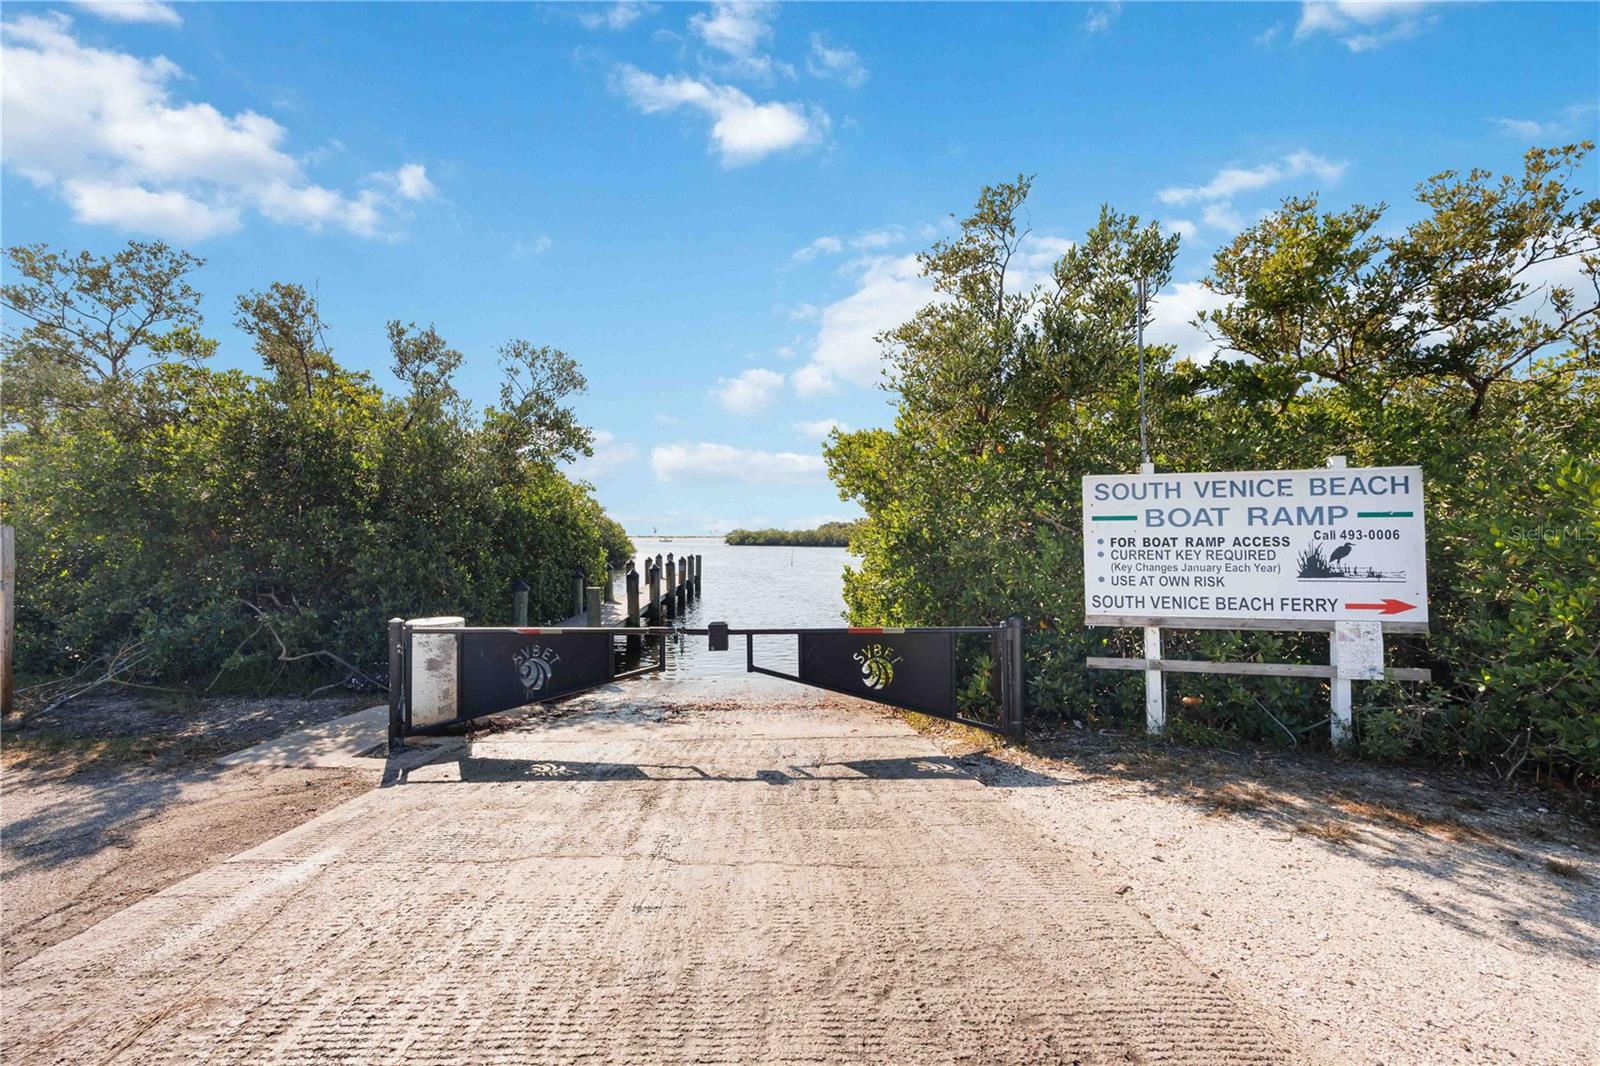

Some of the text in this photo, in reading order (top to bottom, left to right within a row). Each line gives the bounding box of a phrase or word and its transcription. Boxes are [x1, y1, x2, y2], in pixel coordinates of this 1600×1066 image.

[1094, 476, 1409, 500] SOUTH VENICE BEACH
[1145, 505, 1348, 527] BOAT RAMP
[1314, 529, 1400, 541] Call 493-0006
[1111, 536, 1290, 548] FOR BOAT RAMP ACCESS
[1111, 550, 1276, 562] CURRENT KEY REQUIRED
[1111, 563, 1281, 574] (Key Changes January Each Year)
[1111, 576, 1225, 587] USE AT OWN RISK
[1092, 595, 1338, 612] SOUTH VENICE BEACH FERRY
